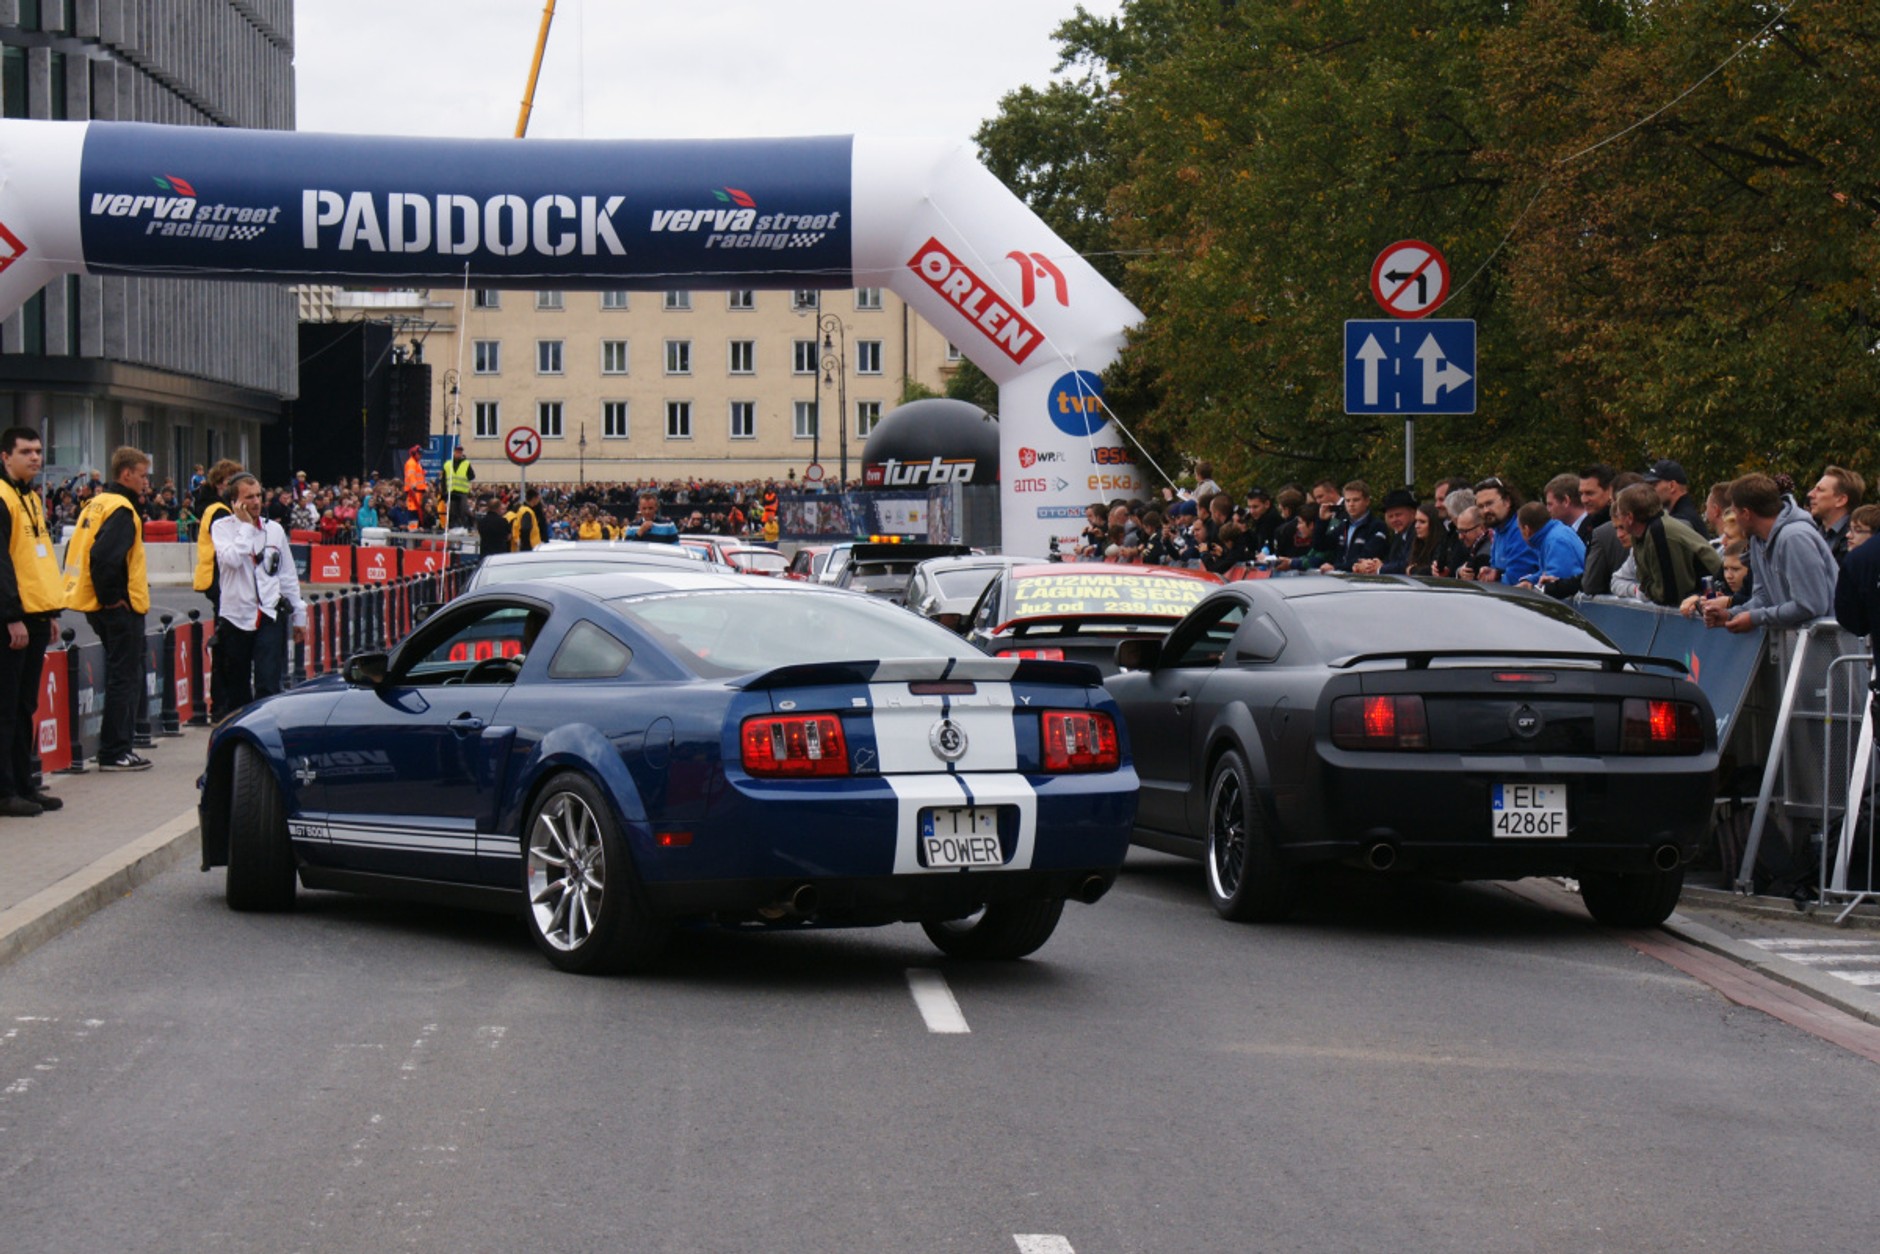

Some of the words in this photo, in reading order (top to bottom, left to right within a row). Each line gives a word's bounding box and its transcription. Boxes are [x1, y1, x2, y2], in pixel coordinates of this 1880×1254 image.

[90, 192, 197, 220] verva
[196, 203, 281, 224] street
[145, 220, 230, 241] racing
[302, 189, 627, 256] PADDOCK
[650, 208, 757, 232] verva
[756, 211, 841, 231] street
[704, 230, 790, 250] racing
[920, 251, 1034, 354] ORLEN
[878, 456, 976, 486] turbo
[1014, 478, 1047, 493] ams
[1015, 587, 1120, 600] LAGUNA
[1130, 588, 1201, 603] SECA
[1058, 602, 1083, 612] od
[1514, 786, 1544, 808] EL
[1497, 812, 1563, 834] 4286F
[928, 837, 999, 864] POWER
